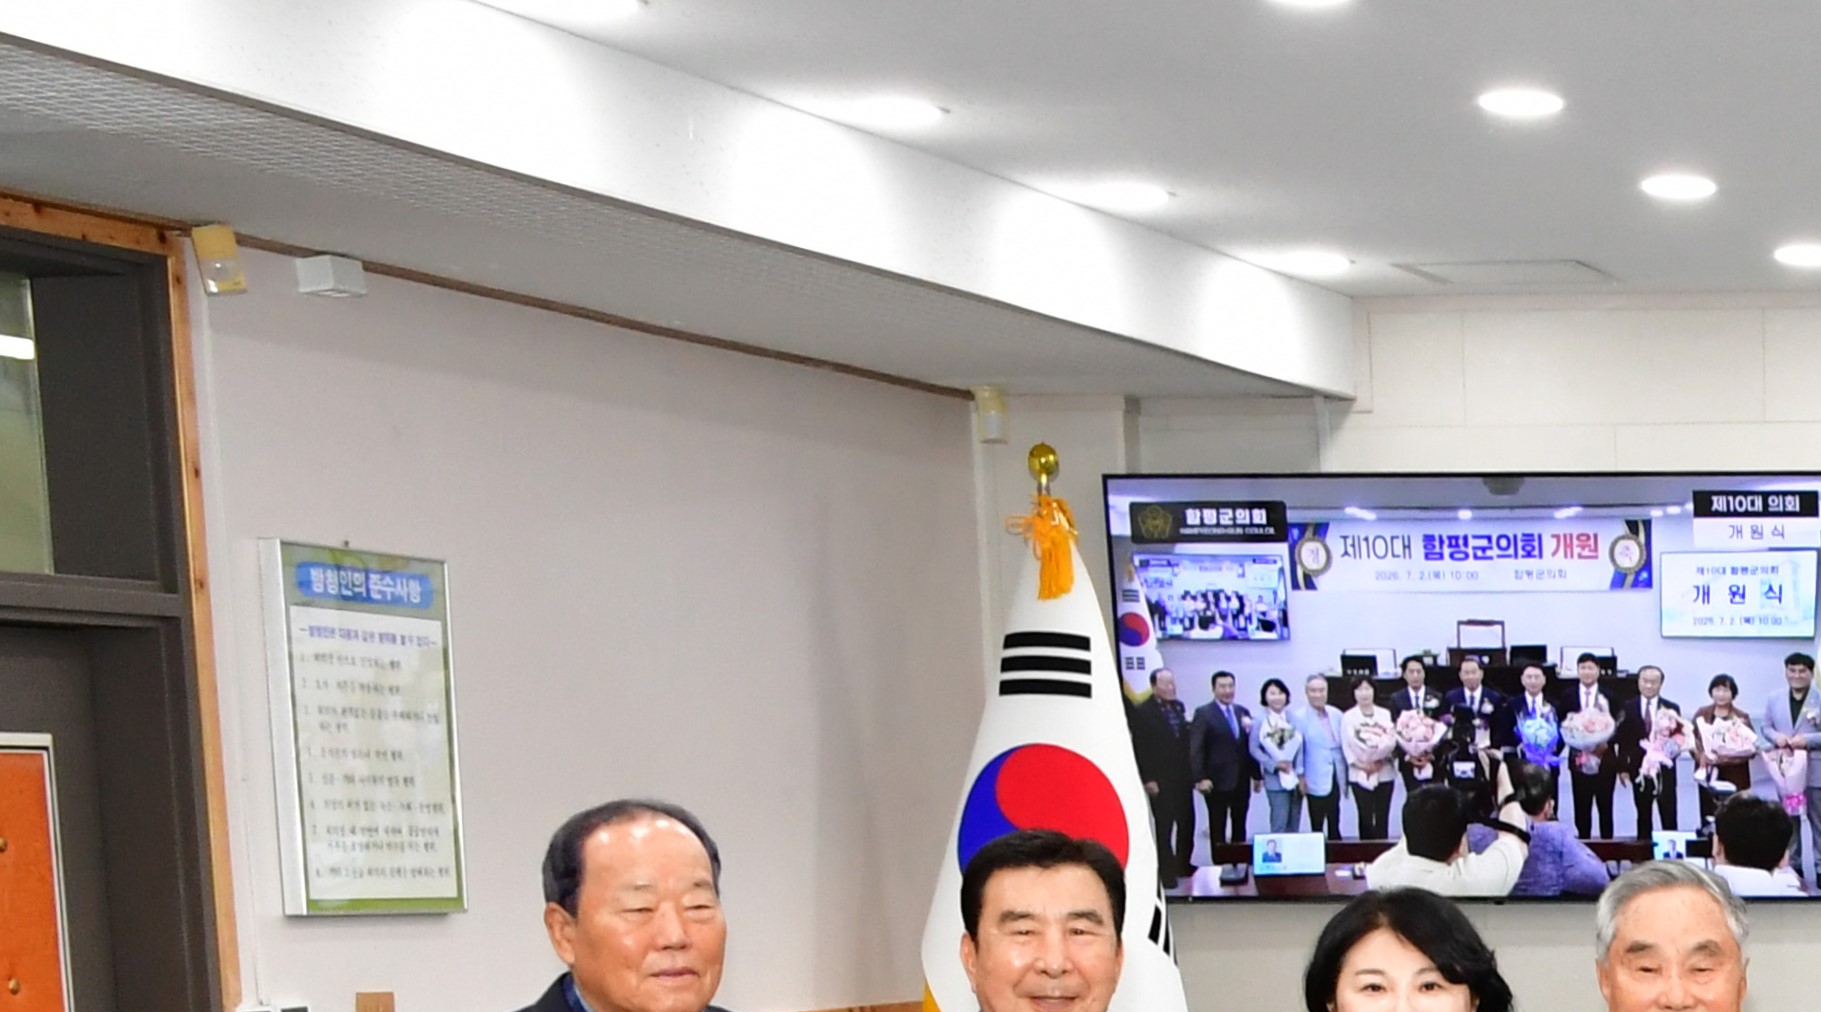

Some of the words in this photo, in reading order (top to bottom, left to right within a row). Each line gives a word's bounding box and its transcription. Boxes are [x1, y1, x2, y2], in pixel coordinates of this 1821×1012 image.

[1711, 495, 1762, 512] 제10대
[1768, 495, 1800, 512] 의회
[1185, 508, 1267, 525] 함평군의회
[1340, 534, 1412, 560] 제10대
[1421, 532, 1544, 562] 함평군의회
[1550, 532, 1599, 560] 개원
[1692, 584, 1710, 605] 개
[1728, 584, 1746, 605] 원
[1764, 584, 1783, 605] 식
